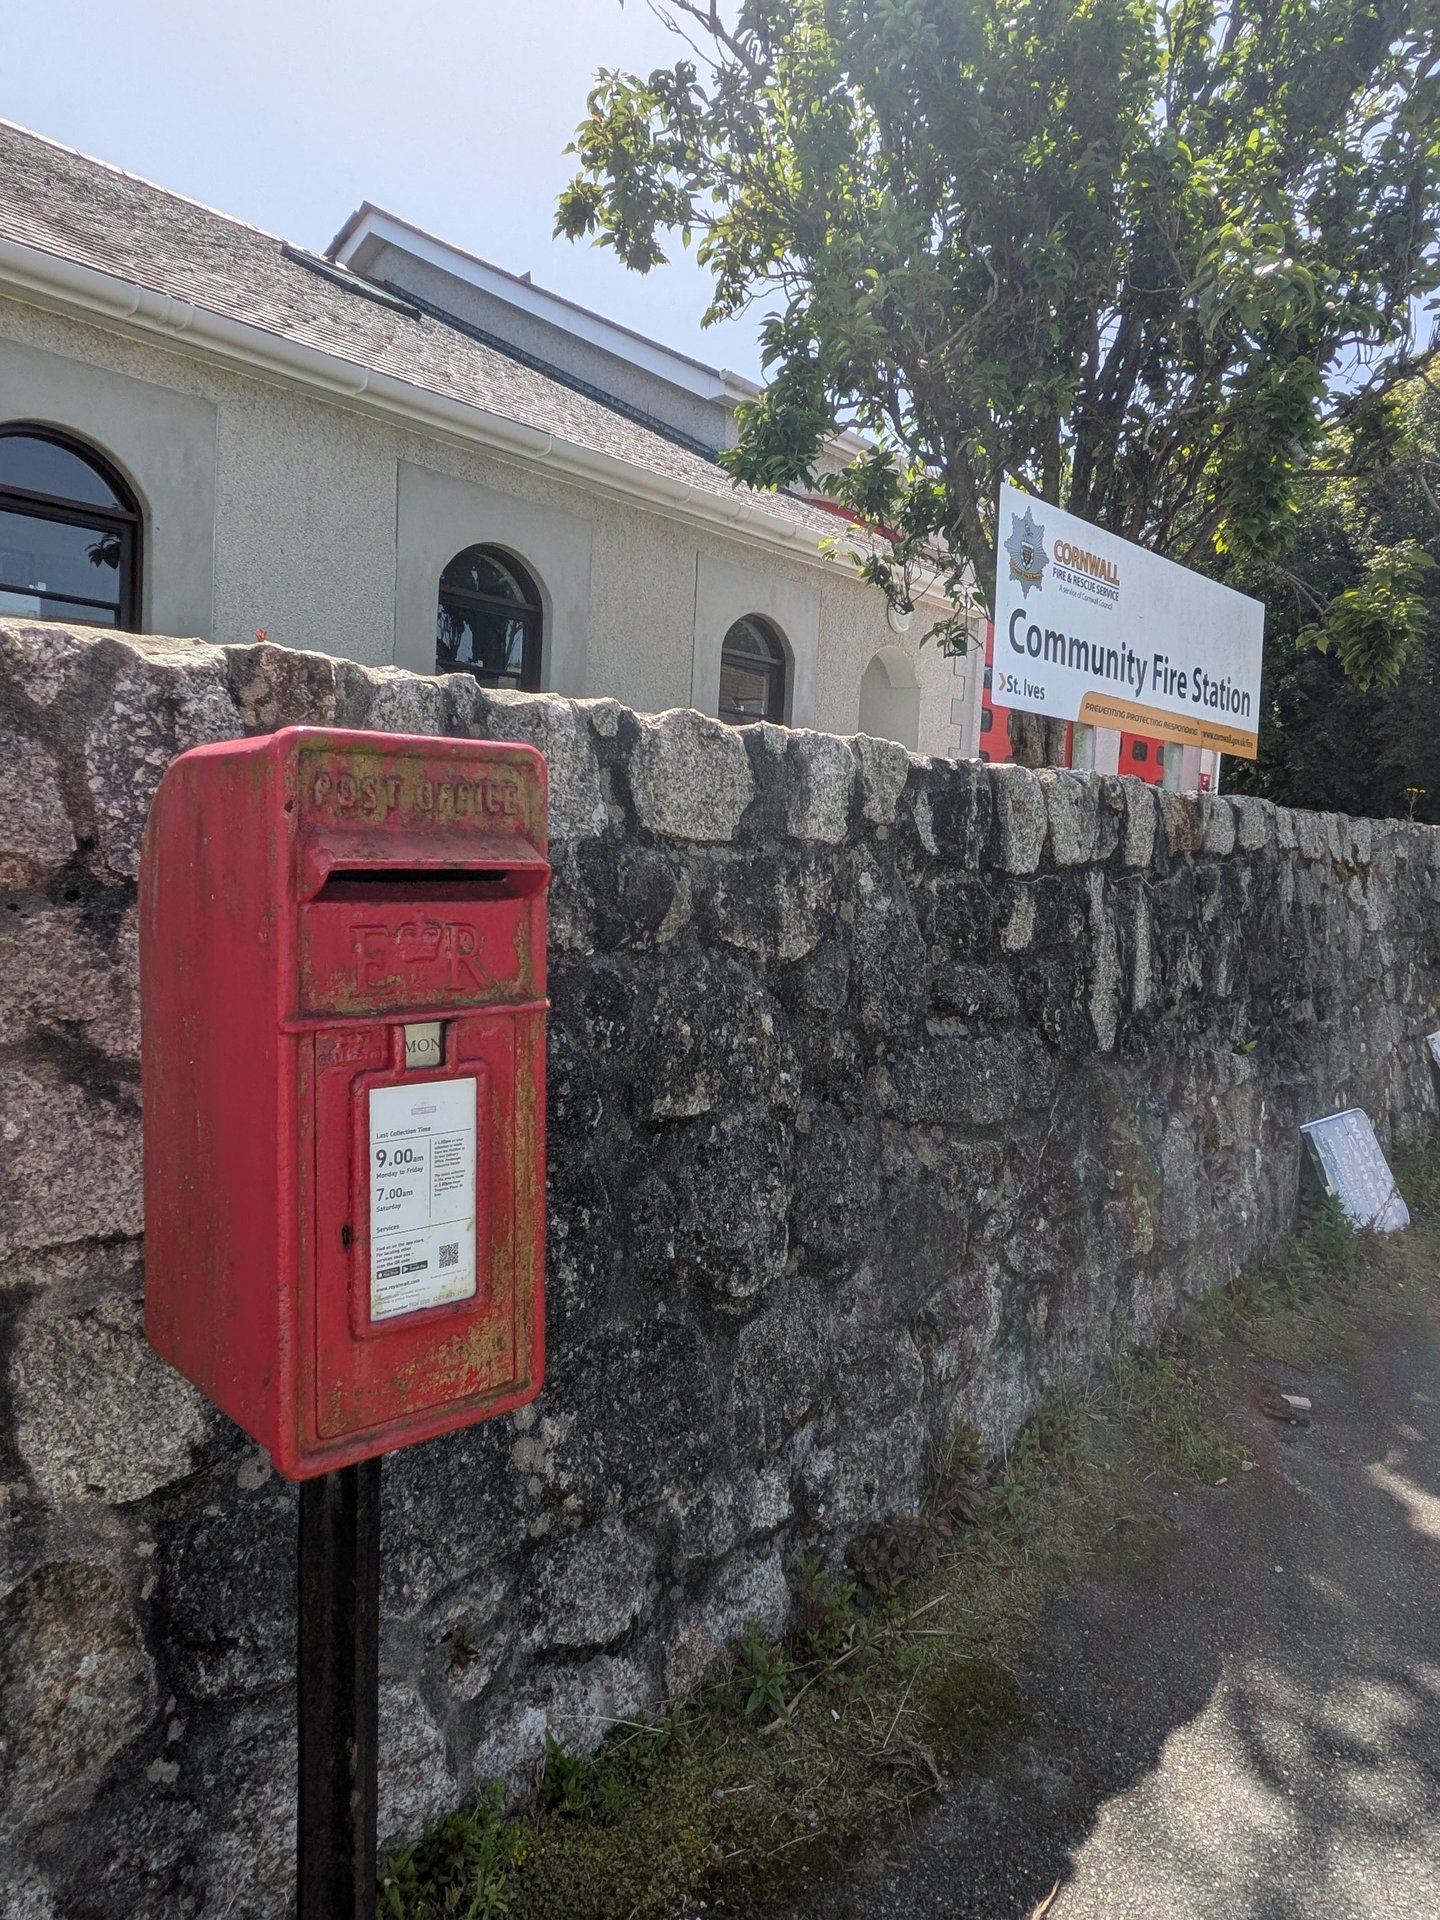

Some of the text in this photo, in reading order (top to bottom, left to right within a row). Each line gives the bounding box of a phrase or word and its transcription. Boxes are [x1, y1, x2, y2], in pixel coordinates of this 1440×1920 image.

[1054, 540, 1120, 586] CORNWALL
[1052, 567, 1066, 582] FIRE
[1067, 573, 1072, 584] &
[1073, 575, 1096, 592] RESCUE
[1096, 584, 1119, 602] SERVICE
[1063, 587, 1076, 598] service
[1082, 593, 1098, 605] Cornwall
[1099, 599, 1113, 610] Council
[1008, 608, 1250, 717] Community Fire Station
[1006, 674, 1045, 700] St. Ives
[1085, 702, 1125, 719] PREVENTING
[1126, 712, 1162, 728] PROTECTING
[1164, 722, 1198, 736] RESPONDING
[314, 770, 520, 815] POST OFFICE
[404, 1038, 440, 1054] MON
[390, 1128, 416, 1137] Collection
[376, 1148, 424, 1168] 9.00am
[376, 1188, 413, 1202] 7.00am
[376, 1204, 401, 1212] Saturday
[376, 1224, 400, 1234] Services
